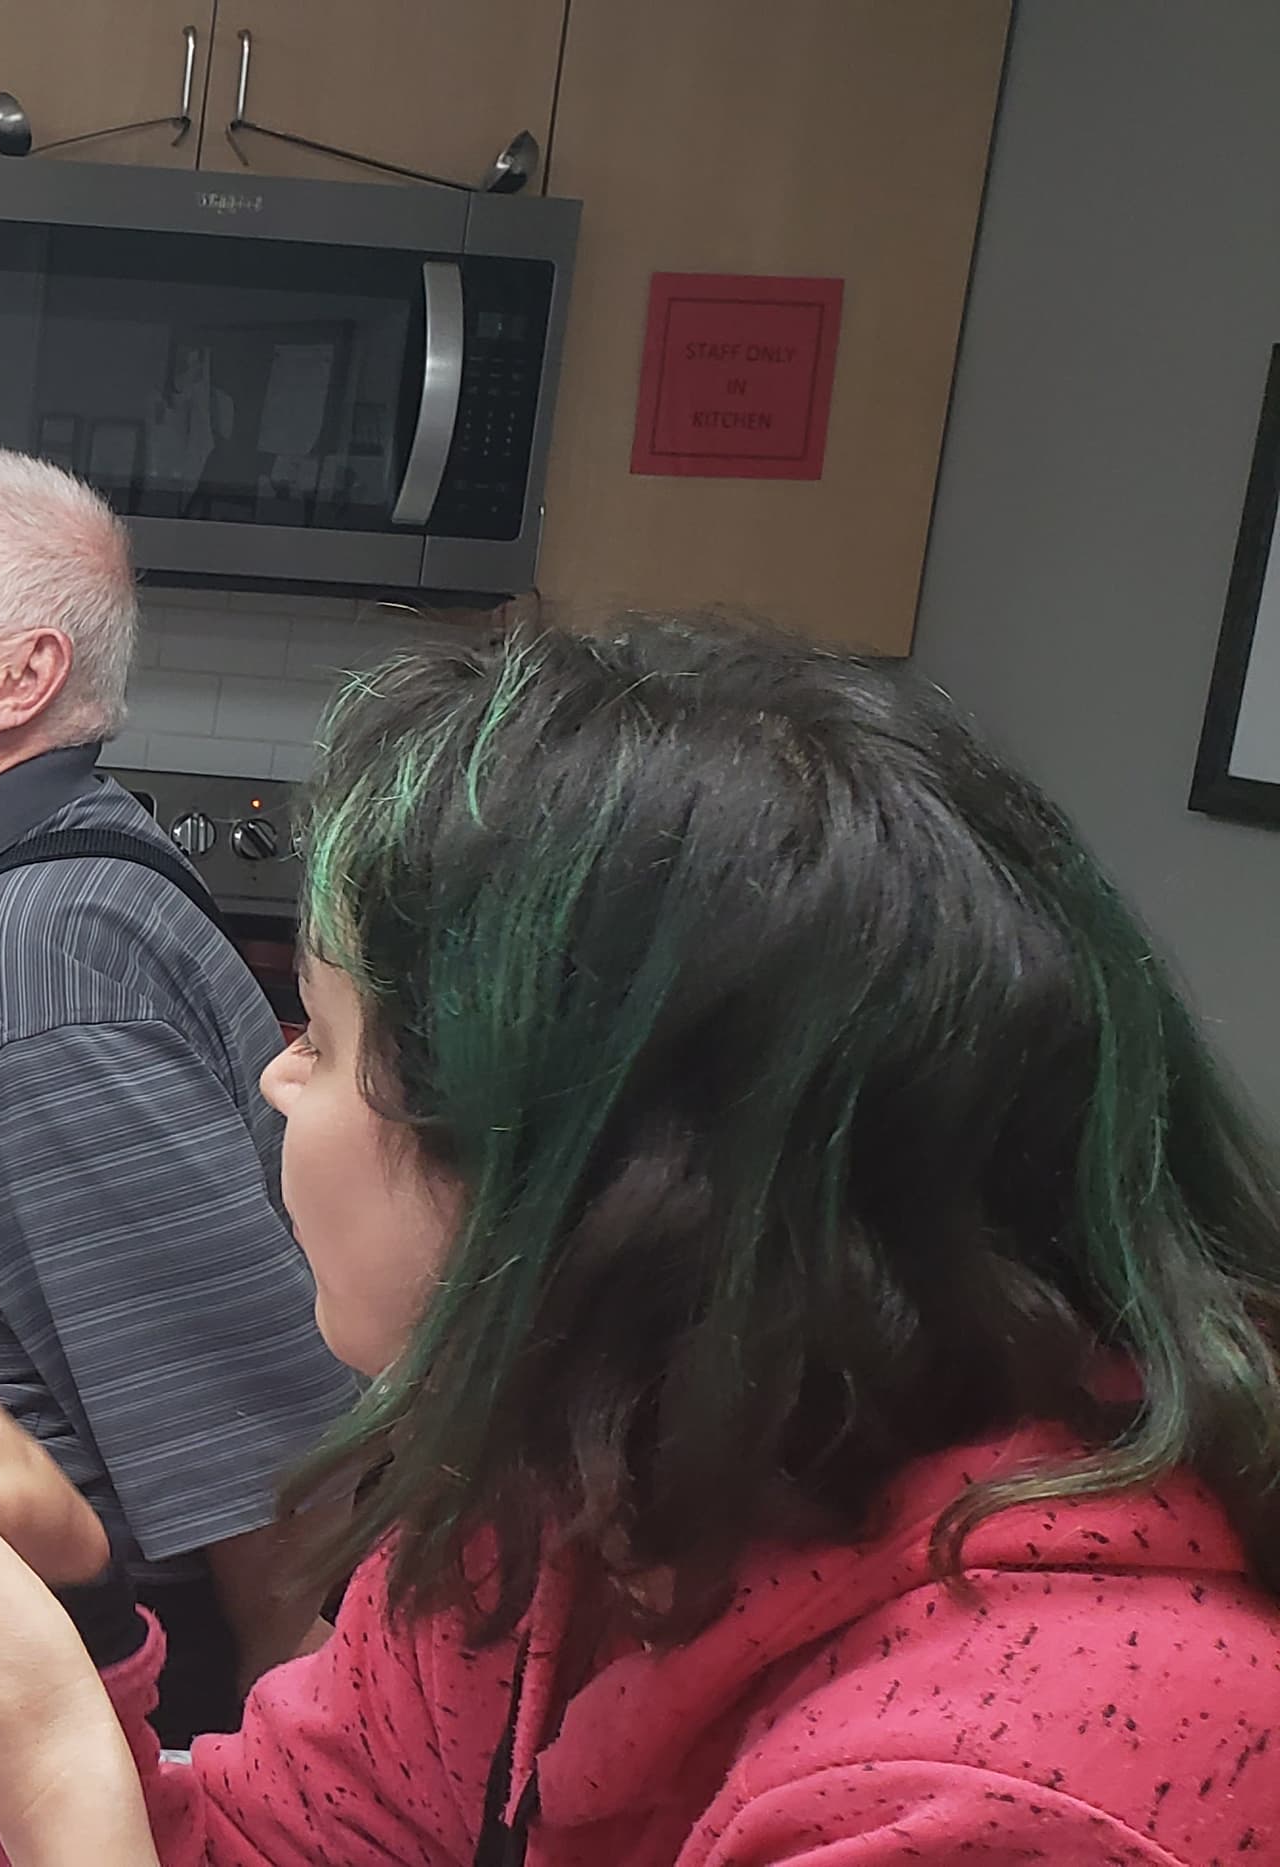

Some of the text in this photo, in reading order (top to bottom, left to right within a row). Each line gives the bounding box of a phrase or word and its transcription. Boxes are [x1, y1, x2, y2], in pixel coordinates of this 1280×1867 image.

[685, 341, 799, 363] STAFF ONLY
[727, 377, 748, 396] IN
[691, 411, 773, 430] KITCHEN
